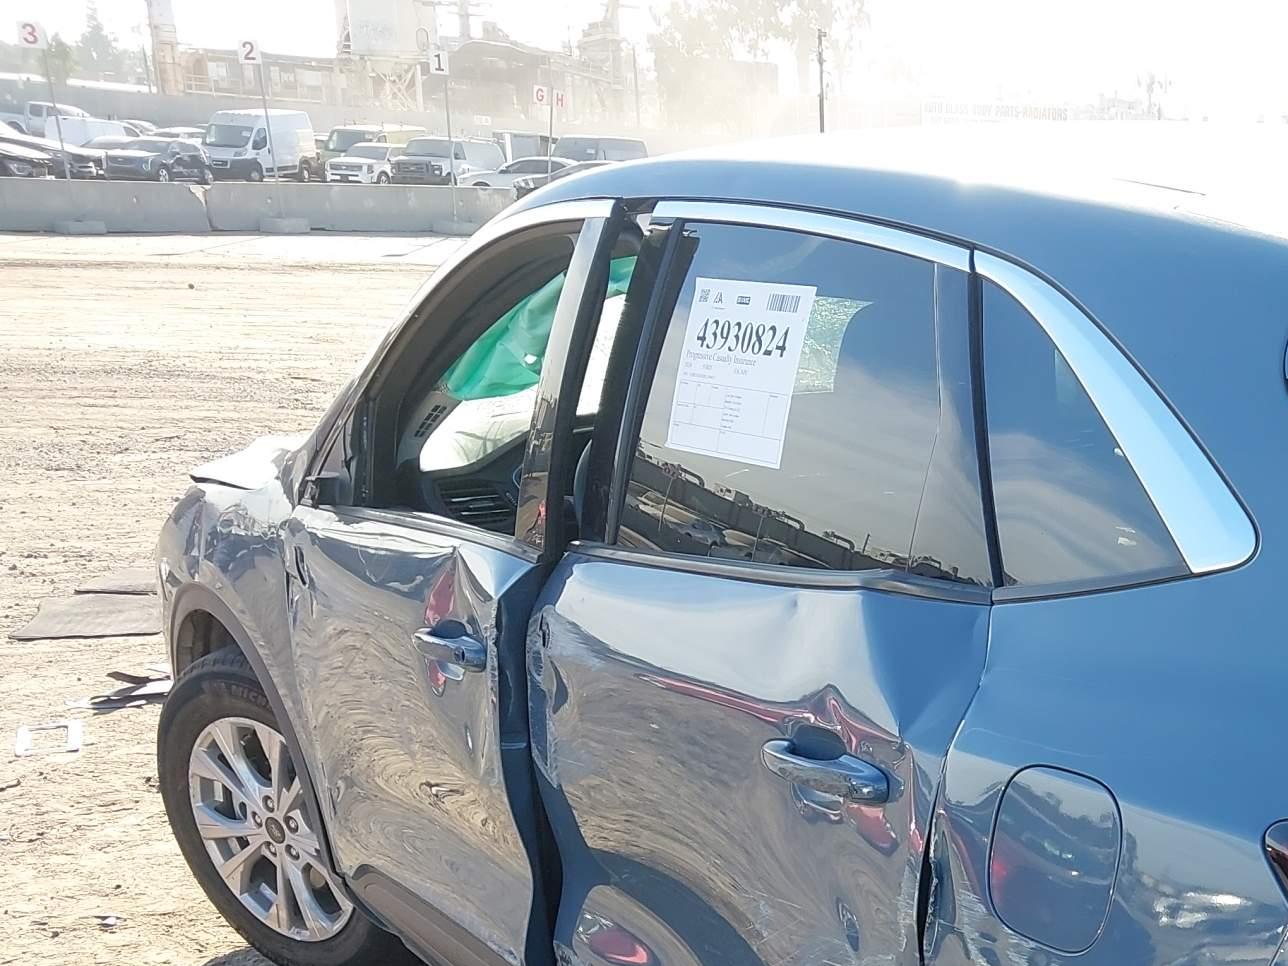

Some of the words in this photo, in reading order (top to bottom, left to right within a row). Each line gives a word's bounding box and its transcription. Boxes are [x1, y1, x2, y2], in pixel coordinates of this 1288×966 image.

[21, 22, 39, 45] 3
[241, 41, 257, 61] 2
[432, 52, 446, 72] 1
[535, 88, 545, 102] G
[555, 92, 564, 108] H
[696, 318, 790, 358] 43930824
